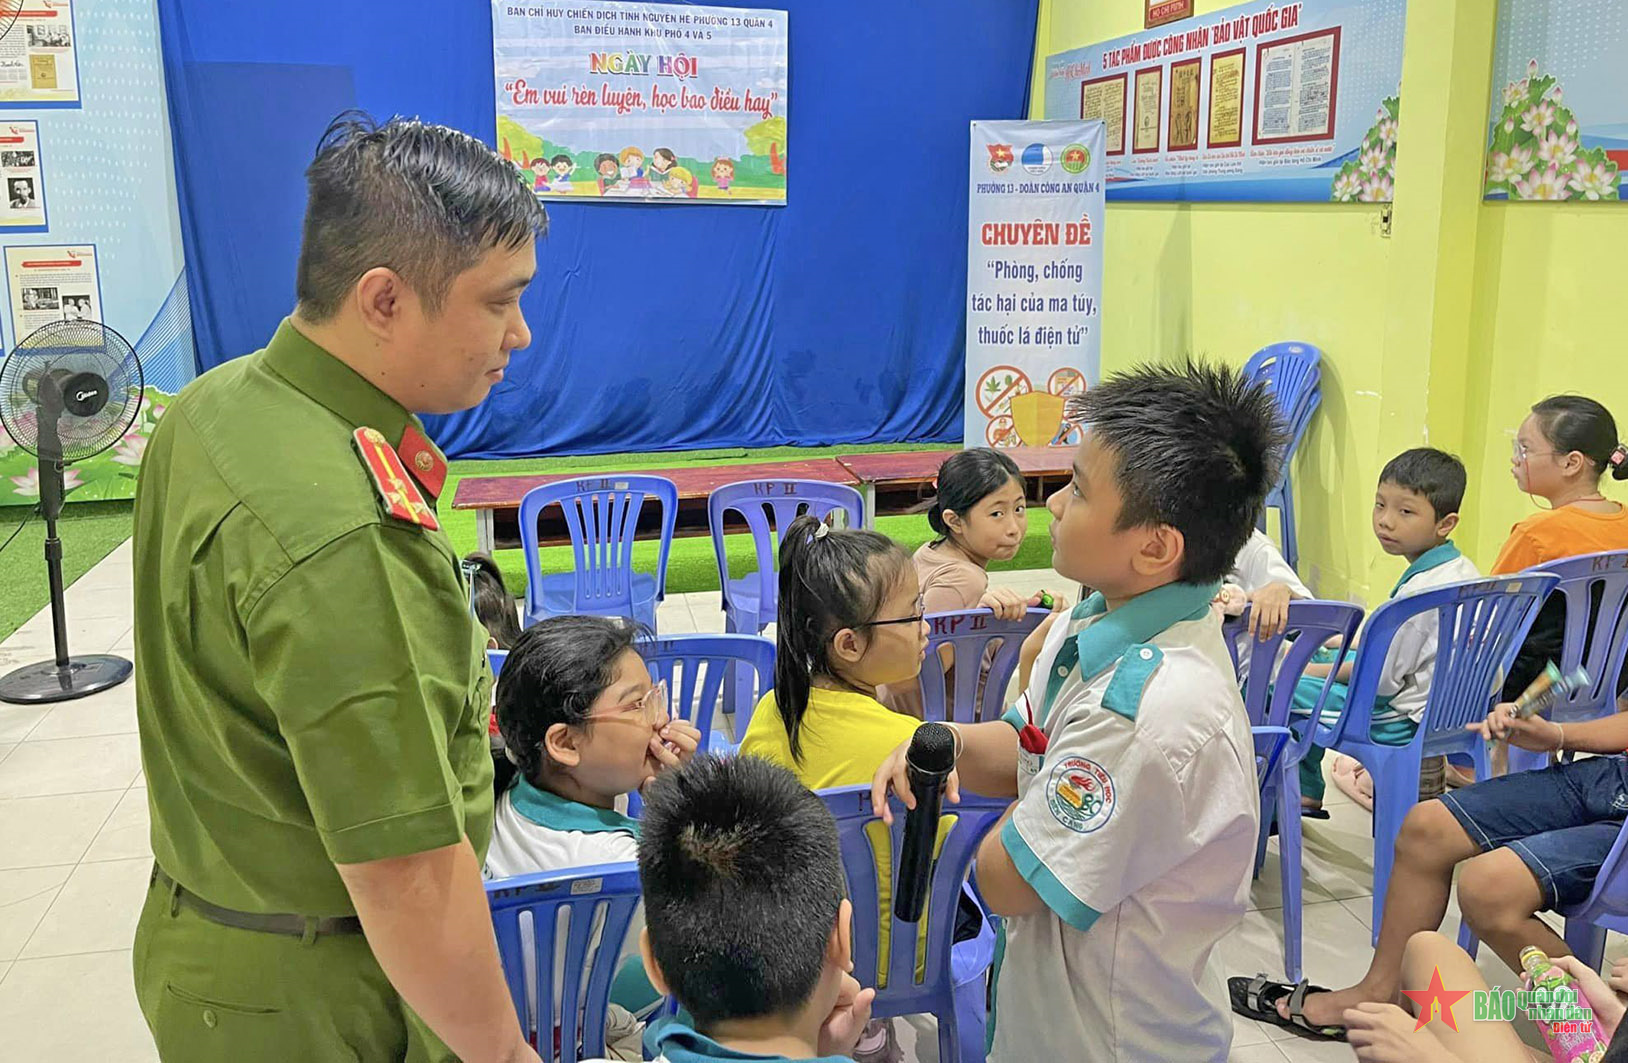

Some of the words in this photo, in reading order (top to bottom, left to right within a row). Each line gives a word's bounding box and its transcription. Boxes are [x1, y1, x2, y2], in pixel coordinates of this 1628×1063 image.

[507, 7, 525, 16] BAN
[528, 5, 544, 17] CHỈ
[546, 8, 564, 18] HUY
[731, 18, 741, 26] 13
[768, 20, 773, 28] 4
[574, 25, 592, 34] BAN
[644, 28, 662, 38] KHU
[684, 31, 690, 39] 4
[706, 32, 712, 40] 5
[1103, 53, 1107, 69] 5
[1121, 40, 1141, 65] PHẨM
[1163, 34, 1183, 56] CÔNG
[1185, 26, 1209, 53] NHẬN
[1233, 15, 1250, 44] VẬT
[1252, 5, 1278, 38] QUỐC
[589, 50, 651, 76] NGÀY
[657, 52, 698, 82] HỘI
[543, 85, 567, 105] vui
[571, 85, 598, 106] rèn
[601, 83, 647, 114] luyện,
[651, 84, 678, 113] học
[680, 86, 706, 109] bao
[710, 86, 741, 111] điều
[977, 181, 1006, 194] PHƯỜNG
[1007, 184, 1014, 194] 13
[1019, 181, 1039, 194] ĐOÀN
[1040, 181, 1060, 194] CÔNG
[1061, 183, 1073, 193] AN
[1073, 181, 1094, 195] QUẬN
[1095, 183, 1100, 193] 4
[981, 219, 1060, 245] CHUYÊN
[1065, 213, 1091, 245] ĐỀ
[987, 260, 1039, 283] “Phòng,
[1043, 258, 1083, 283] chống
[972, 293, 992, 312] tác
[997, 293, 1016, 316] hại
[1020, 292, 1044, 312] của
[1049, 297, 1068, 312] ma
[1072, 293, 1097, 316] túy,
[978, 323, 1014, 345] thuốc
[1018, 326, 1030, 345] lá
[1035, 326, 1063, 349] điện
[753, 481, 775, 495] KP
[783, 482, 798, 494] II
[934, 614, 966, 634] KP
[969, 613, 990, 629] II
